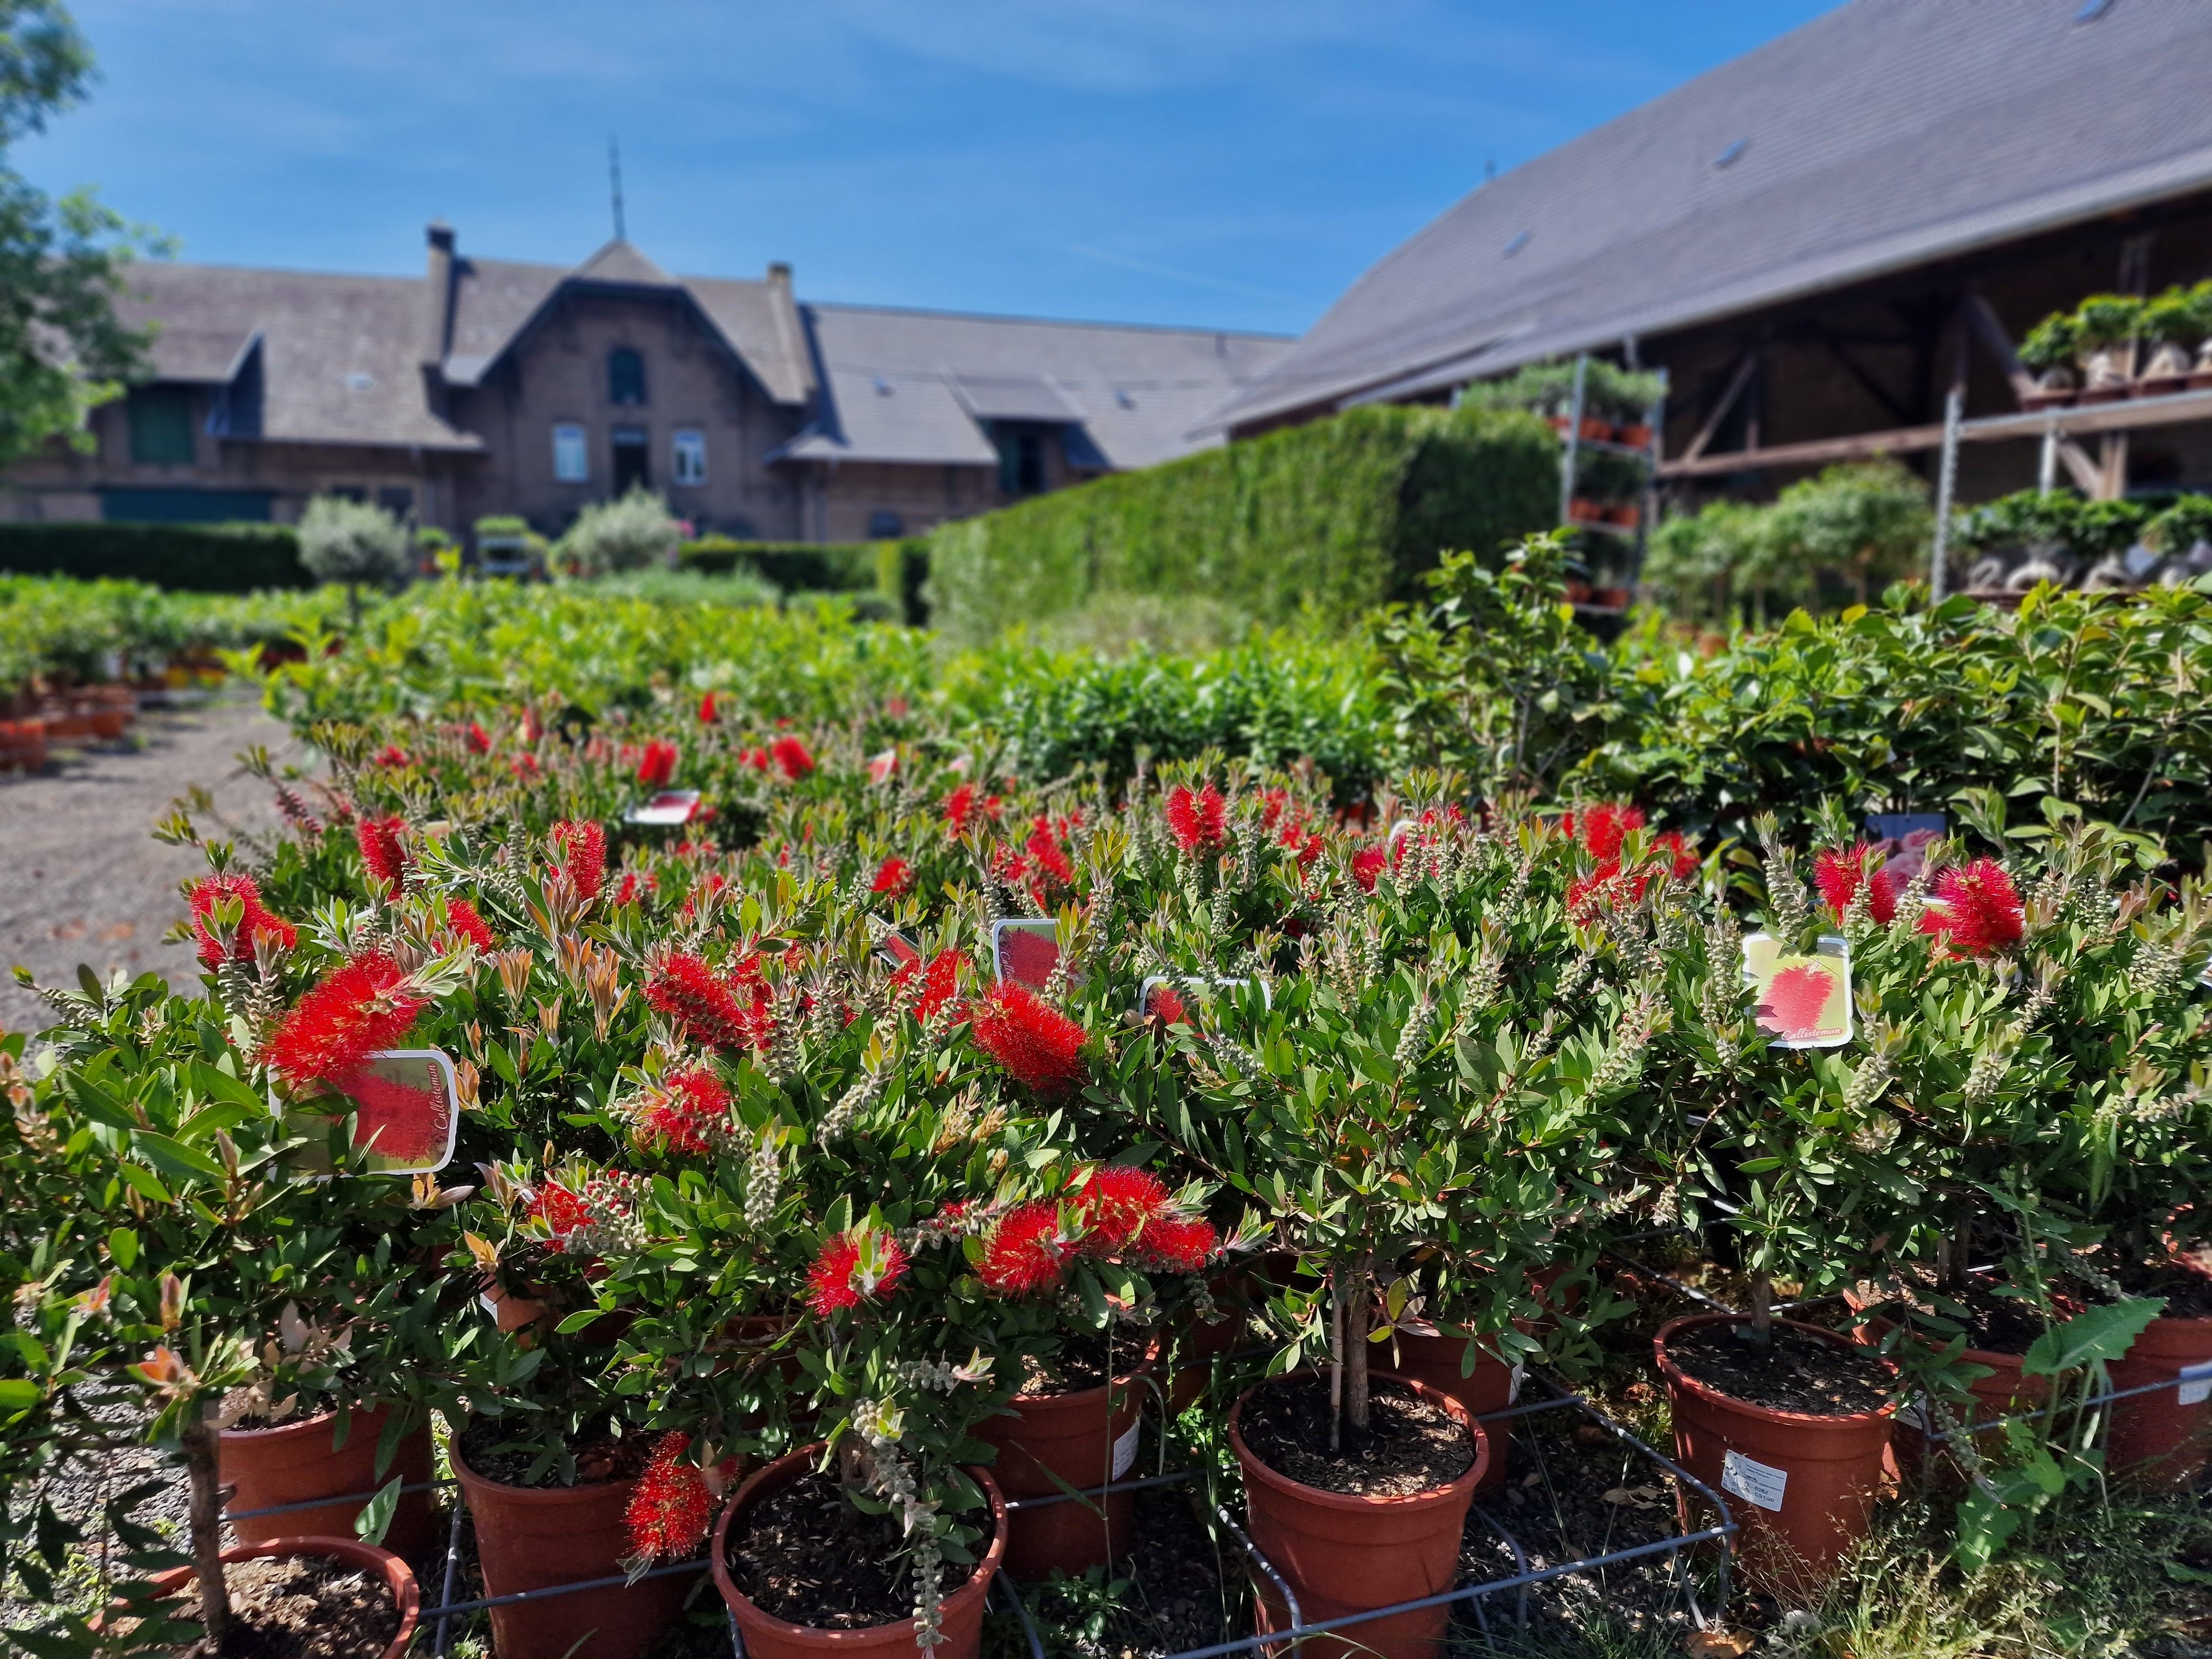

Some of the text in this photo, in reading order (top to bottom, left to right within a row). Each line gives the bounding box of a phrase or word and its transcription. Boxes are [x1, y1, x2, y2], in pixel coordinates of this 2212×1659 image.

[1000, 952, 1015, 982] Callist
[1781, 1027, 1840, 1041] Callistemon
[428, 1063, 448, 1130] Callistemon
